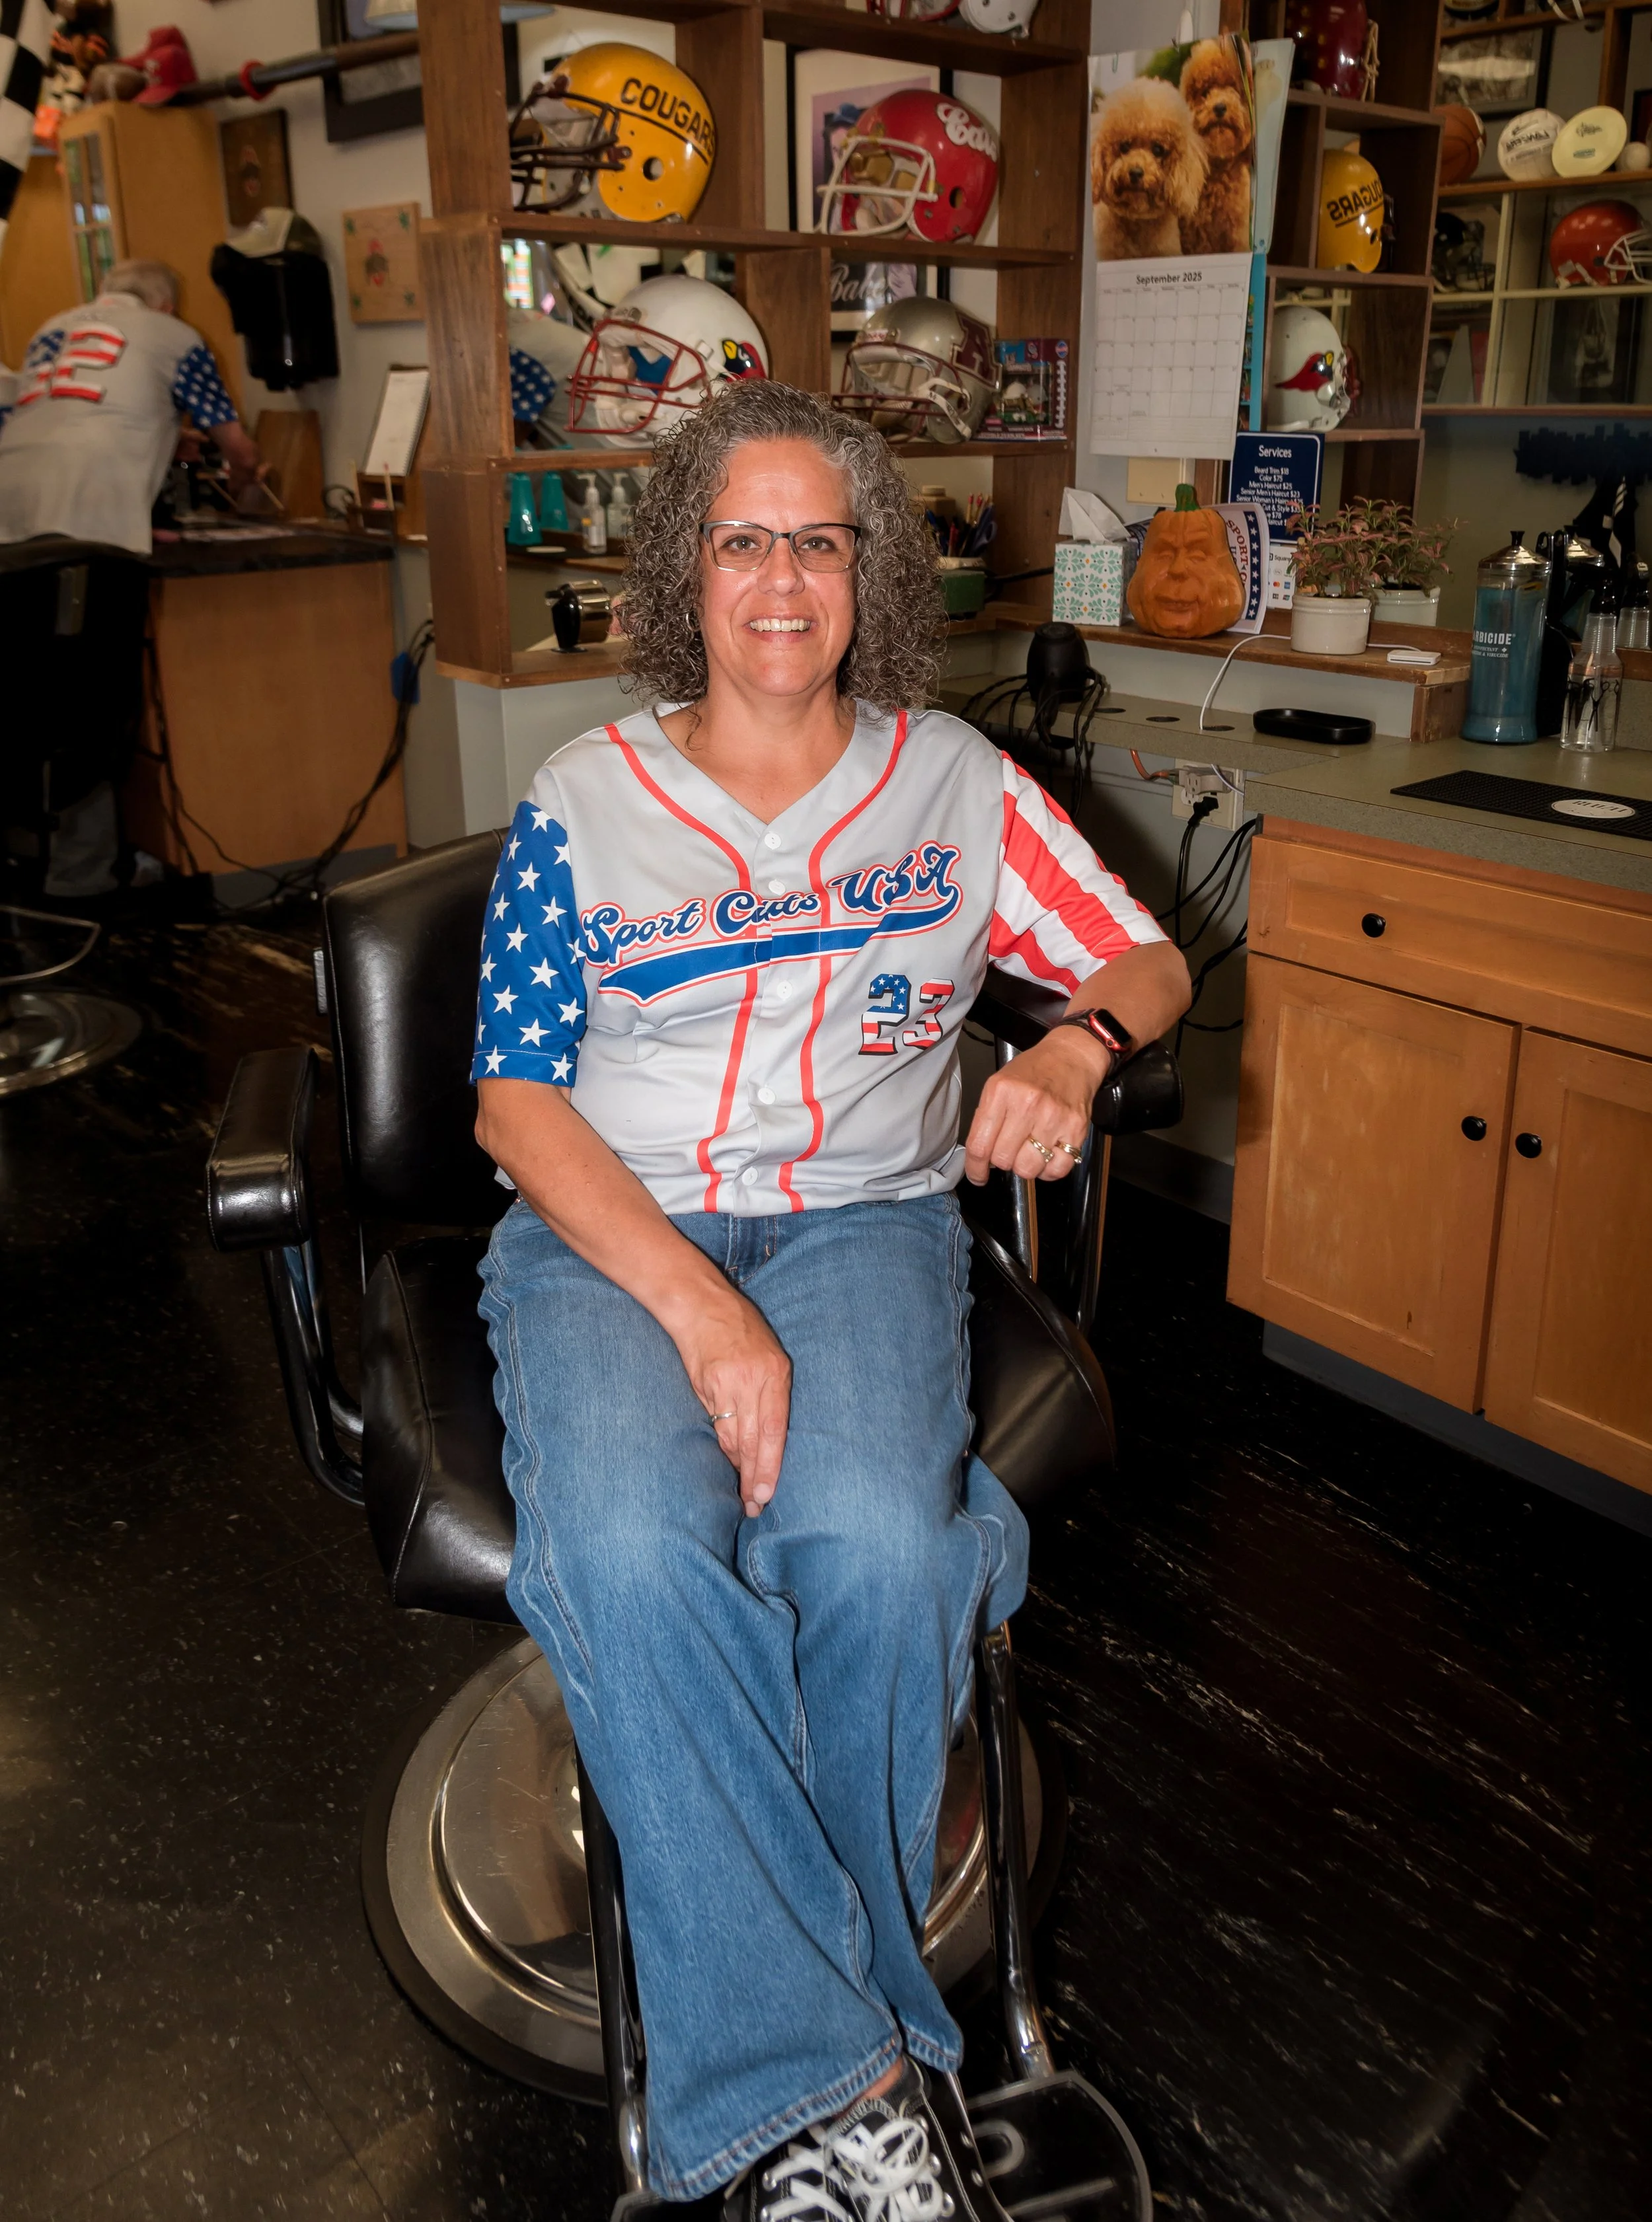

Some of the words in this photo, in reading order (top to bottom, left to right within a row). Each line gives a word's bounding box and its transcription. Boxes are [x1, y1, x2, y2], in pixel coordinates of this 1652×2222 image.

[620, 77, 718, 157] COUGARS
[1136, 274, 1180, 286] September
[1183, 272, 1203, 283] 2025
[1258, 445, 1293, 458] Services
[1277, 505, 1290, 513] Style
[1226, 519, 1248, 566] SPORT
[582, 896, 706, 968] Sport
[710, 889, 823, 940] Cuts
[827, 840, 963, 918] USA
[858, 973, 955, 1056] 23
